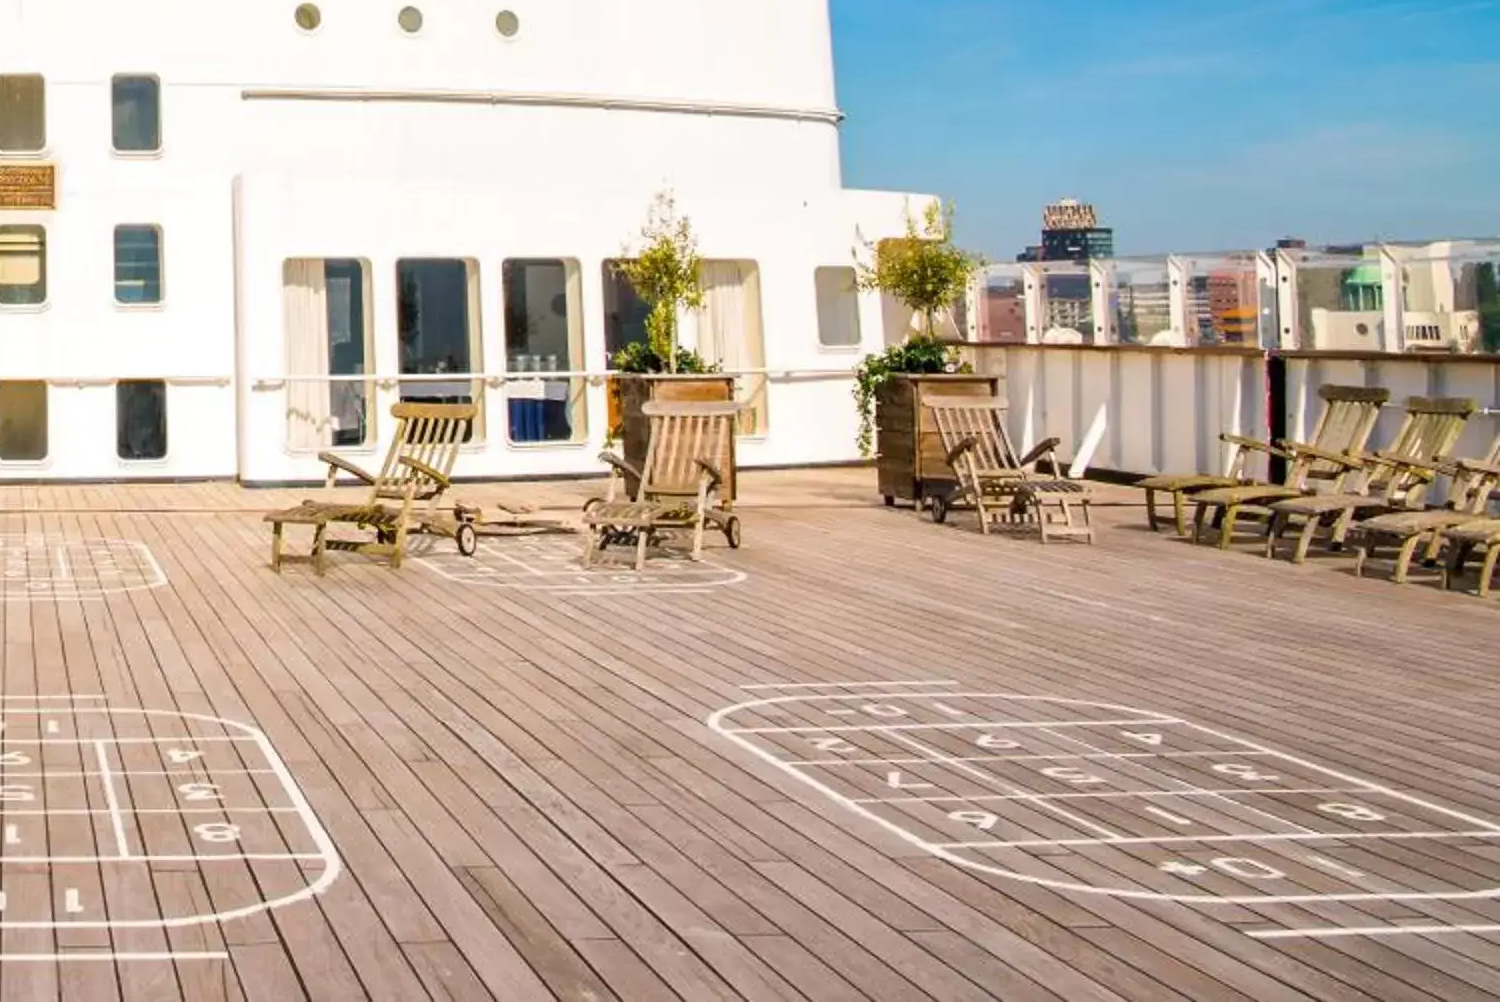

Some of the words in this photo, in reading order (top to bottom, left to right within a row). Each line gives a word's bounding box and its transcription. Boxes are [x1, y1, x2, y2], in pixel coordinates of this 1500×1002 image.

[1120, 730, 1162, 745] 4
[167, 748, 206, 763] 4
[1041, 767, 1106, 784] 5
[177, 783, 223, 800] 3
[1317, 802, 1386, 821] 8
[4, 824, 22, 845] 1
[194, 822, 241, 843] 8
